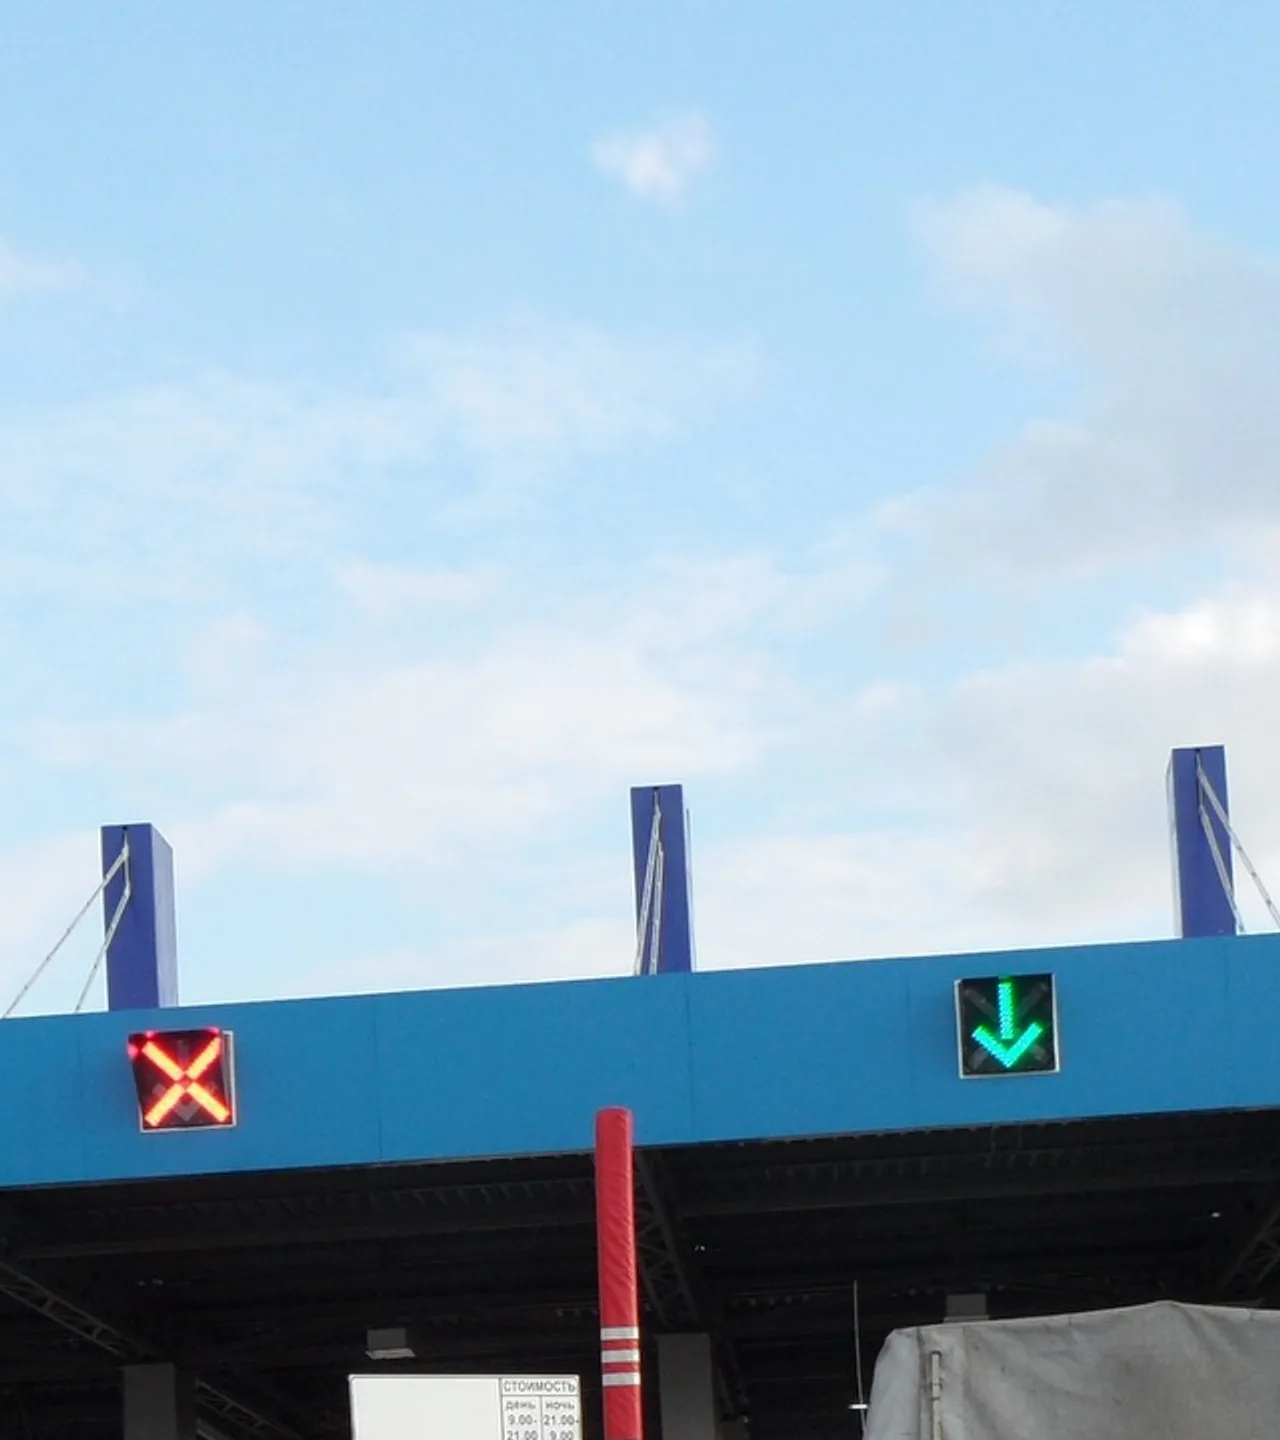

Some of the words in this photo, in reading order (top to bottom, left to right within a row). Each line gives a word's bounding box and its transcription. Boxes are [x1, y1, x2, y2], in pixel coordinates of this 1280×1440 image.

[504, 1380, 576, 1393] СТОИМОСТЬ
[506, 1401, 536, 1411] день
[545, 1402, 575, 1410] ночь
[508, 1414, 537, 1425] 9.00-
[543, 1414, 580, 1426] 21.00-
